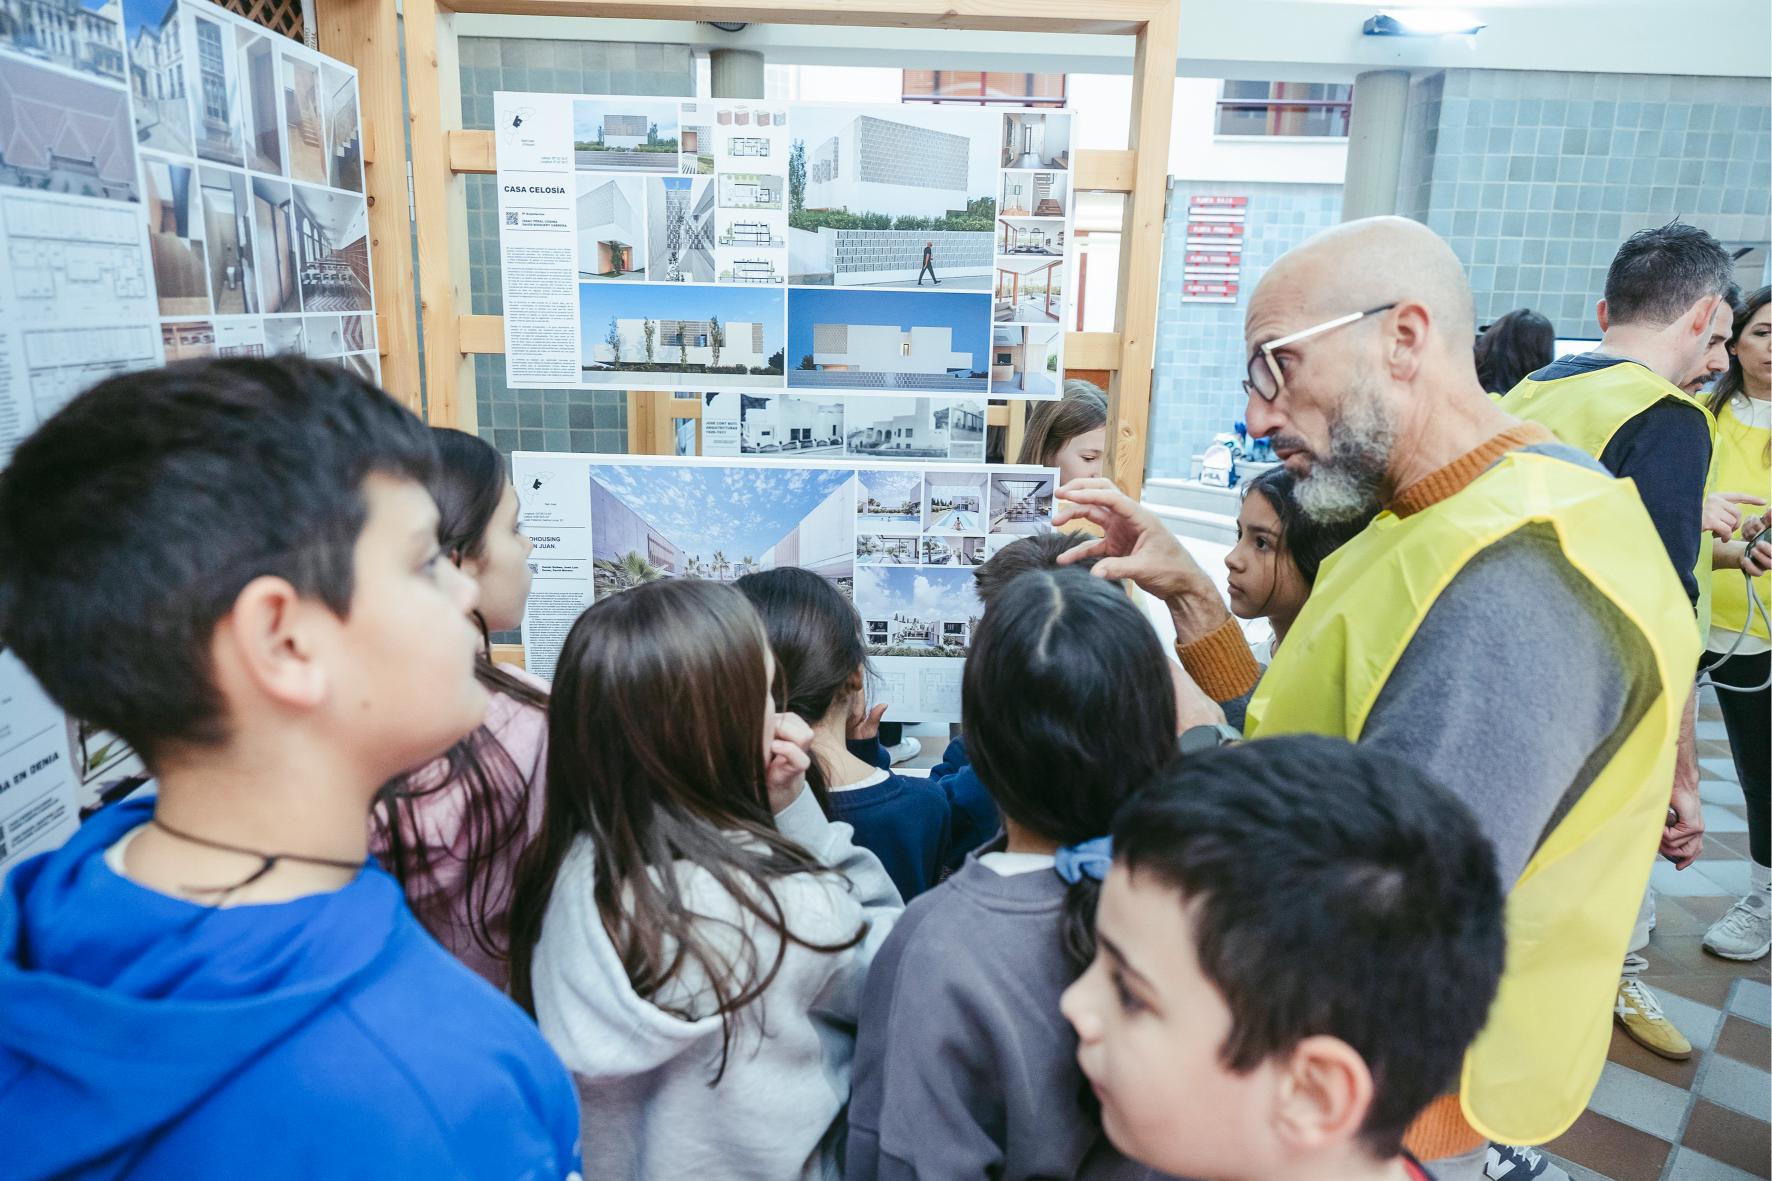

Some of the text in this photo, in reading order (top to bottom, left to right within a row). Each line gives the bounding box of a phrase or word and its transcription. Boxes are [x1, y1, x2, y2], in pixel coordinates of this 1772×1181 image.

[504, 185, 566, 194] CASA CELOSÍA
[13, 769, 28, 785] EN
[29, 751, 60, 775] DENIA
